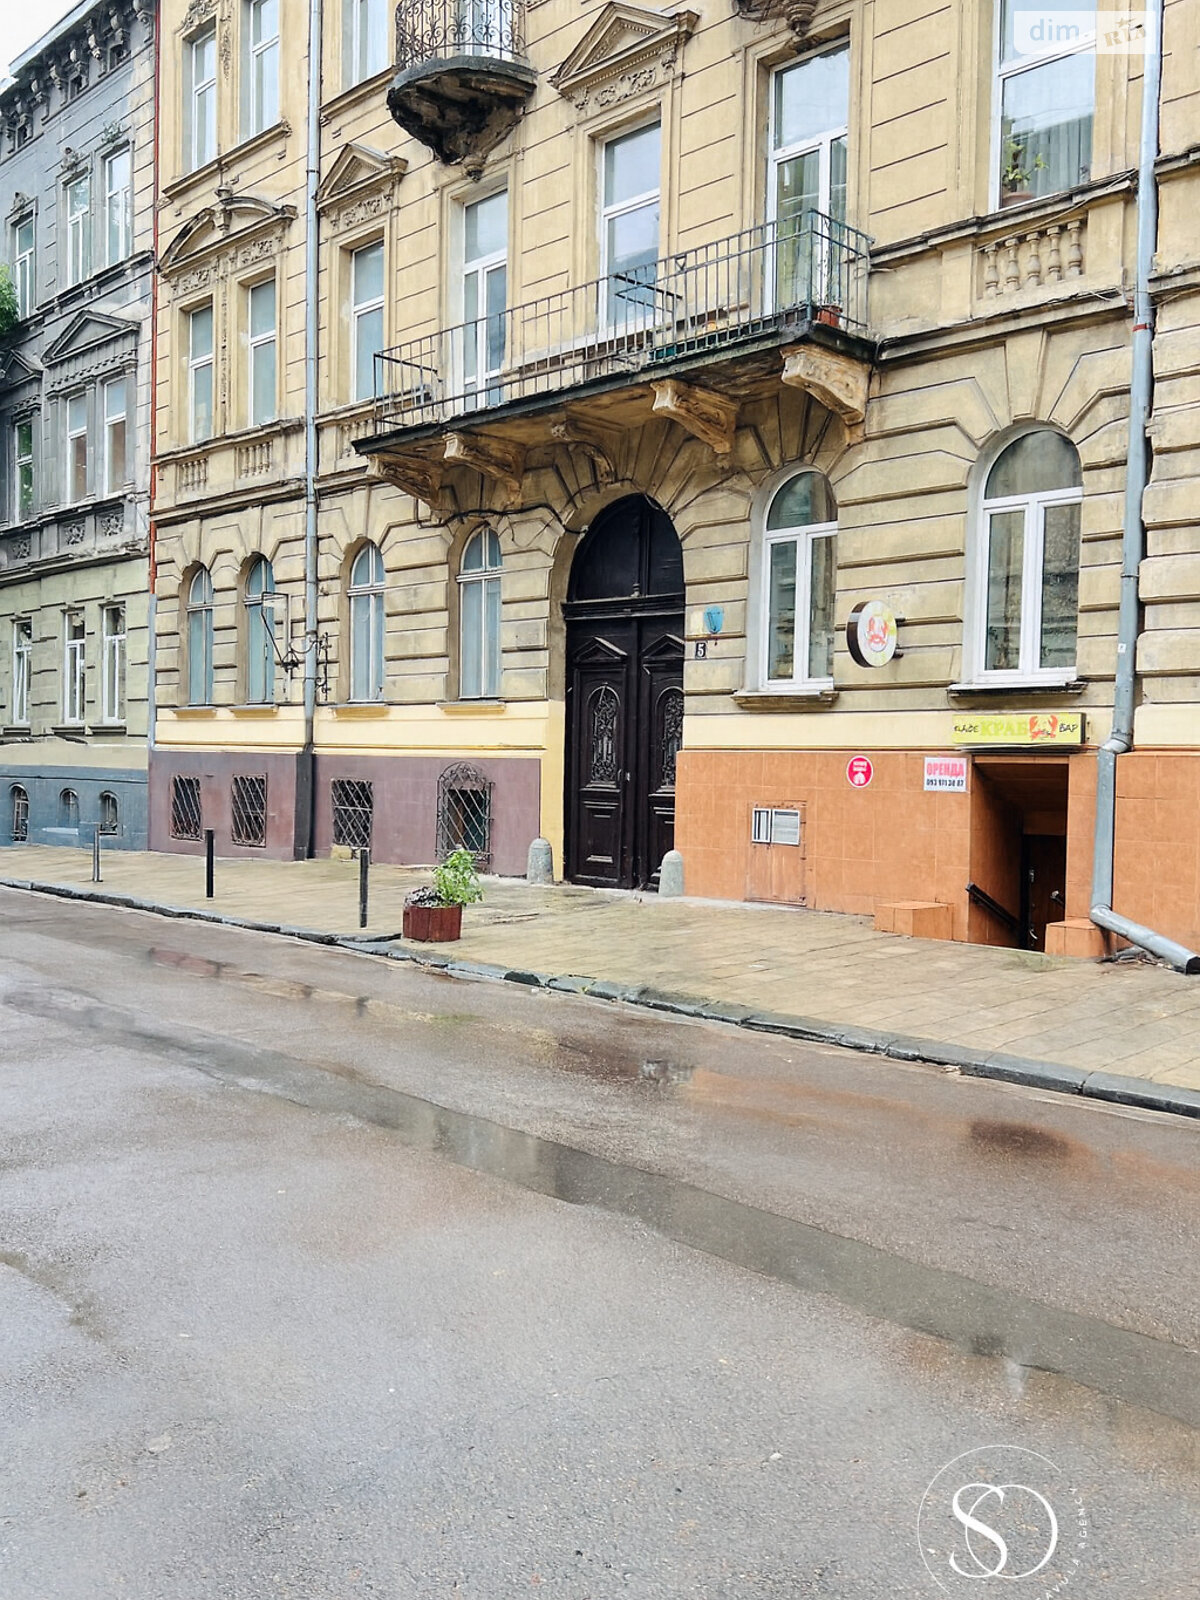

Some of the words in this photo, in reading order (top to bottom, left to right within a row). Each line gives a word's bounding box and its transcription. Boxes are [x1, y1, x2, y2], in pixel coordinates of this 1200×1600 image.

[697, 643, 704, 657] 5
[981, 720, 1028, 736] КРАБ
[926, 762, 964, 777] ОРЕНДА
